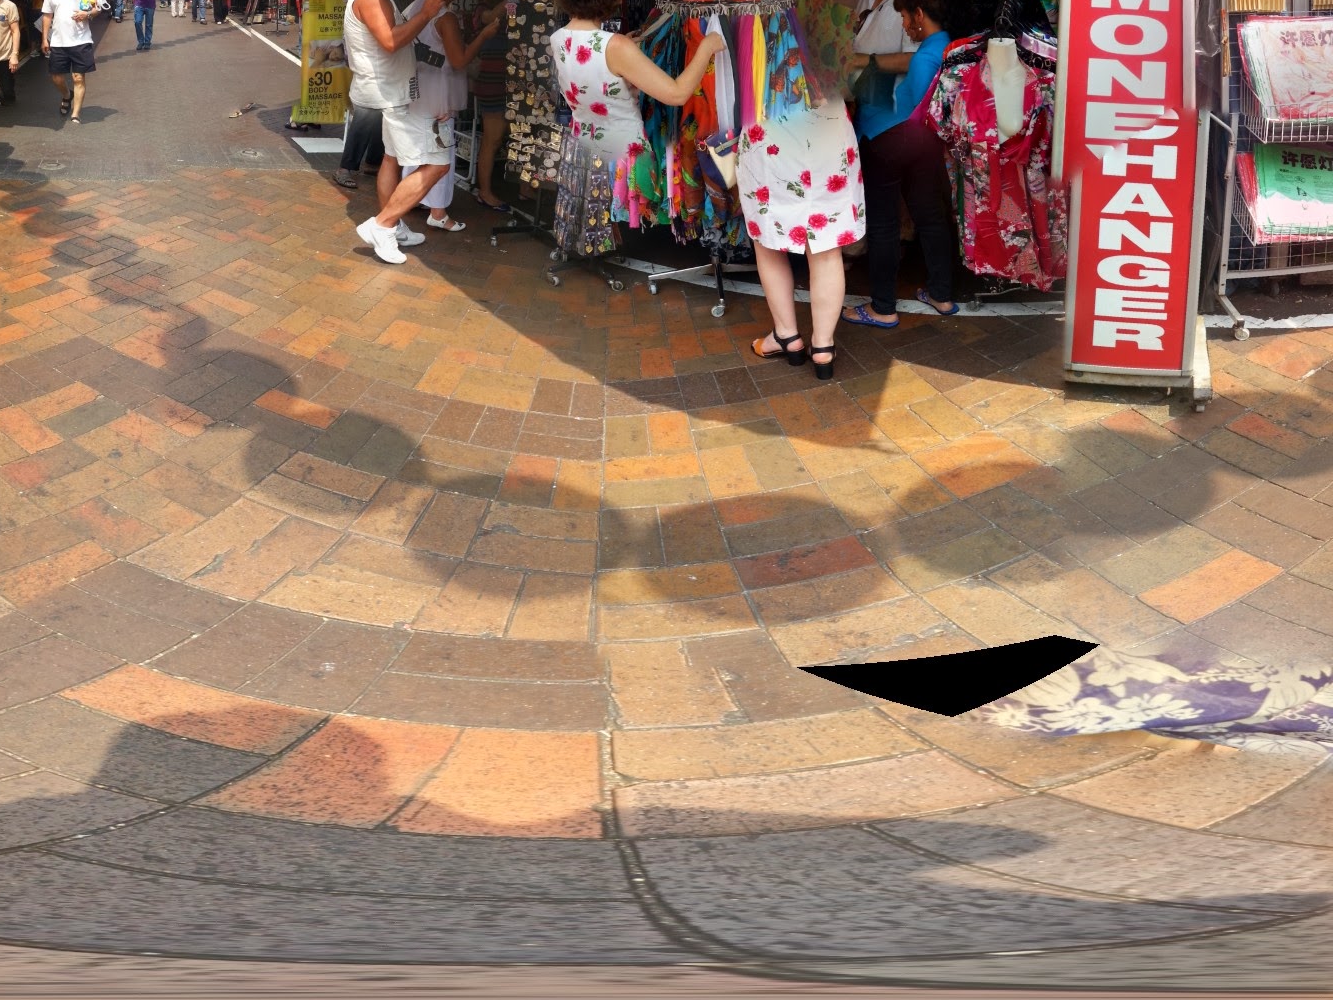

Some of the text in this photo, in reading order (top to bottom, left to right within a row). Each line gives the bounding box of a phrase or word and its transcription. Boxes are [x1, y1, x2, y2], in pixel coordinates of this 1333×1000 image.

[308, 71, 333, 87] $30
[308, 86, 329, 94] BODY
[308, 93, 343, 101] MASSAGE
